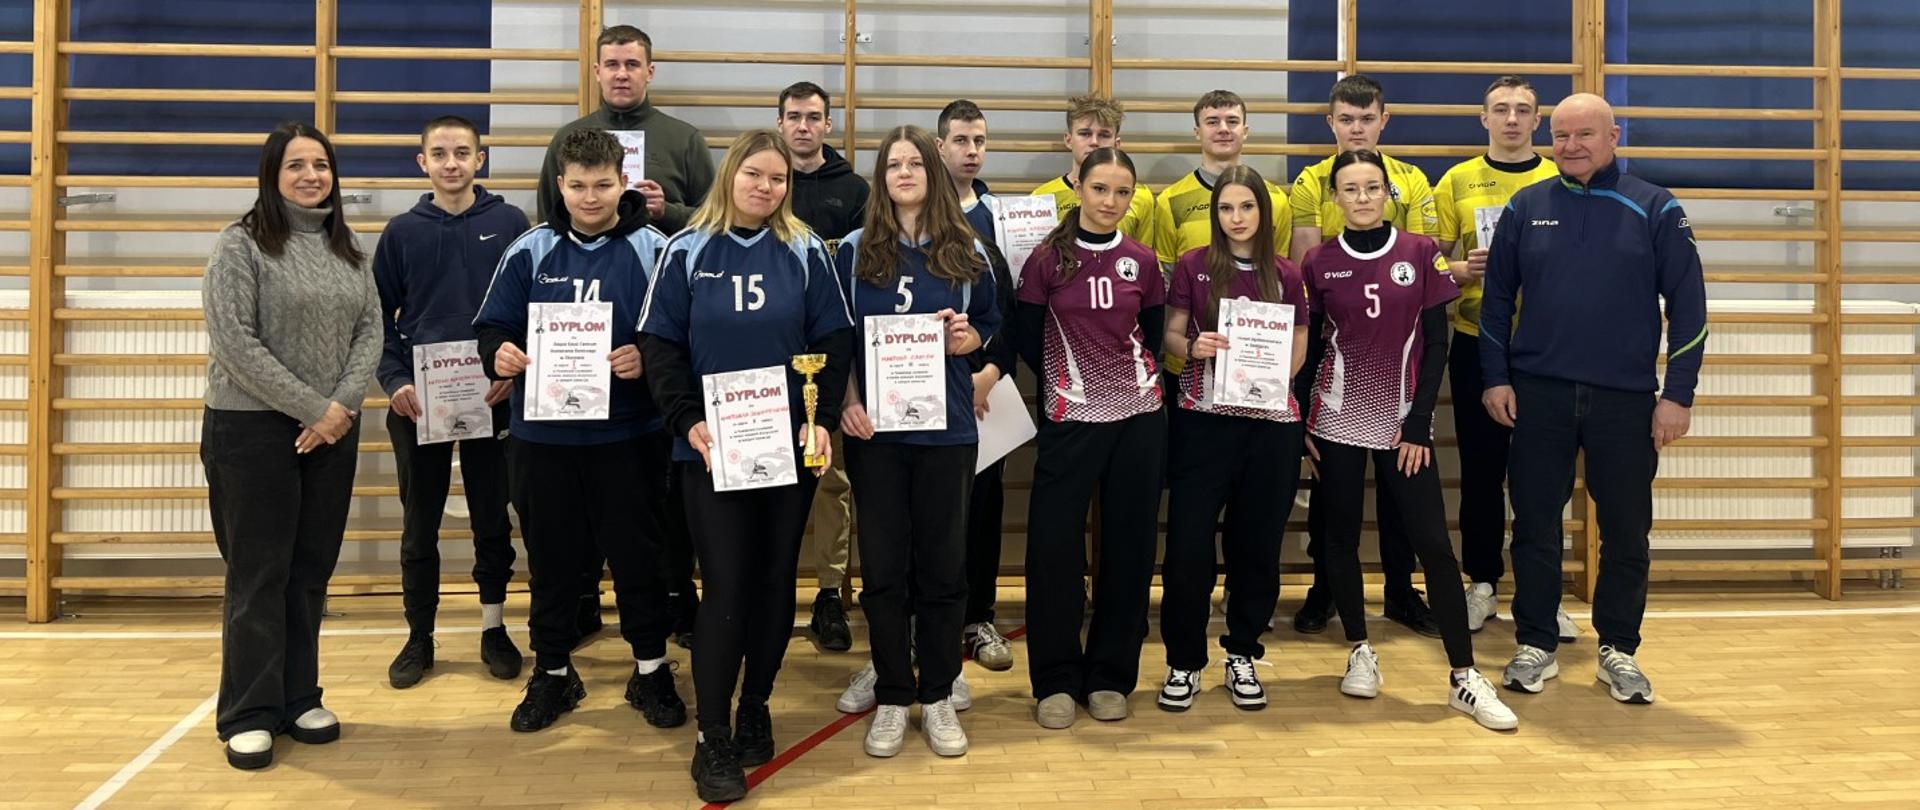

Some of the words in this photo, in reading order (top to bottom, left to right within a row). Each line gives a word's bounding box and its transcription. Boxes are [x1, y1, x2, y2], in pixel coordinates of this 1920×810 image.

[1008, 209, 1053, 219] DYPLOM
[573, 278, 601, 303] 14
[732, 273, 766, 311] 15
[895, 275, 914, 313] 5
[1087, 276, 1113, 310] 10
[1364, 283, 1381, 318] 5
[549, 321, 605, 332] DYPLOM
[1236, 317, 1288, 332] DYPLOM
[885, 333, 938, 344] DYPLOM
[433, 356, 482, 369] DYPLOM
[725, 386, 782, 403] DYPLOM
